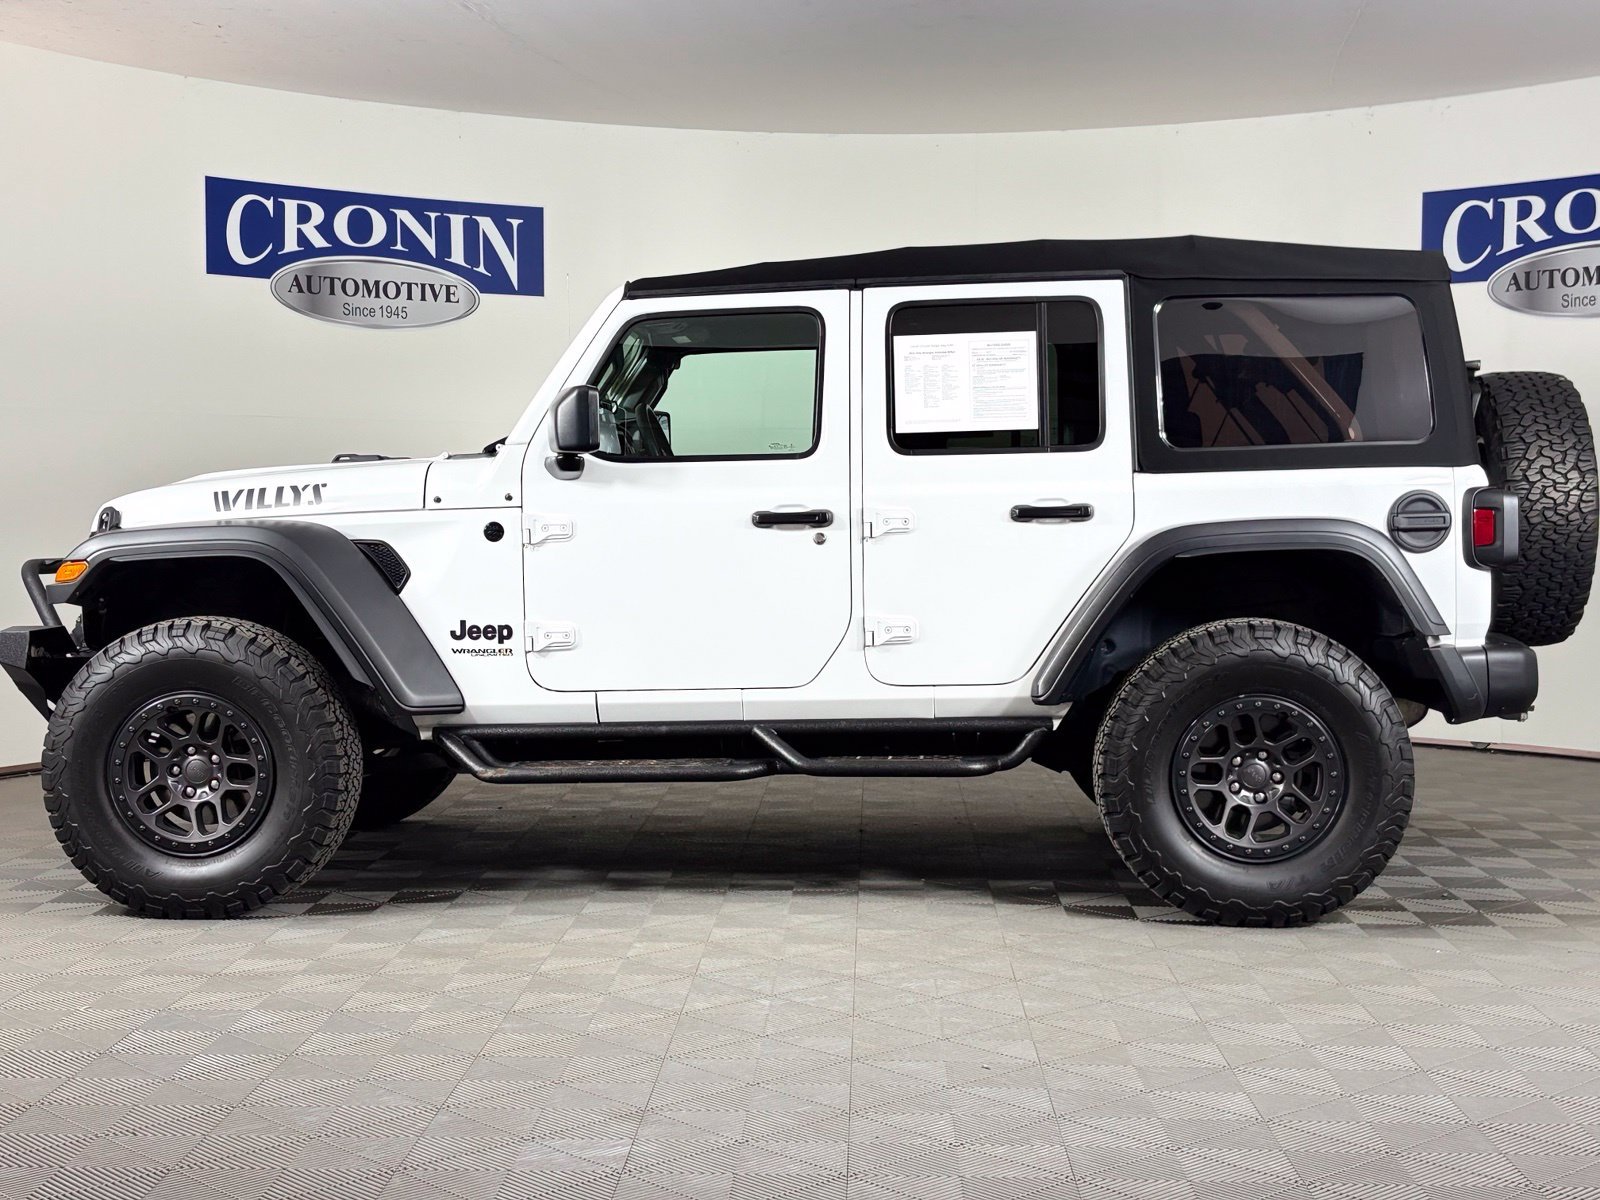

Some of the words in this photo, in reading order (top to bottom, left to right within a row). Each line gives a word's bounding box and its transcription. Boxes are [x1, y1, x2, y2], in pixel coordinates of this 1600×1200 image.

[226, 193, 523, 291] CRONIN
[287, 273, 460, 304] AUTOMOTIVE
[1561, 293, 1596, 309] Since
[342, 302, 376, 318] Since
[378, 305, 408, 320] 1945
[213, 482, 328, 512] WILLYS
[450, 620, 513, 644] Jeep
